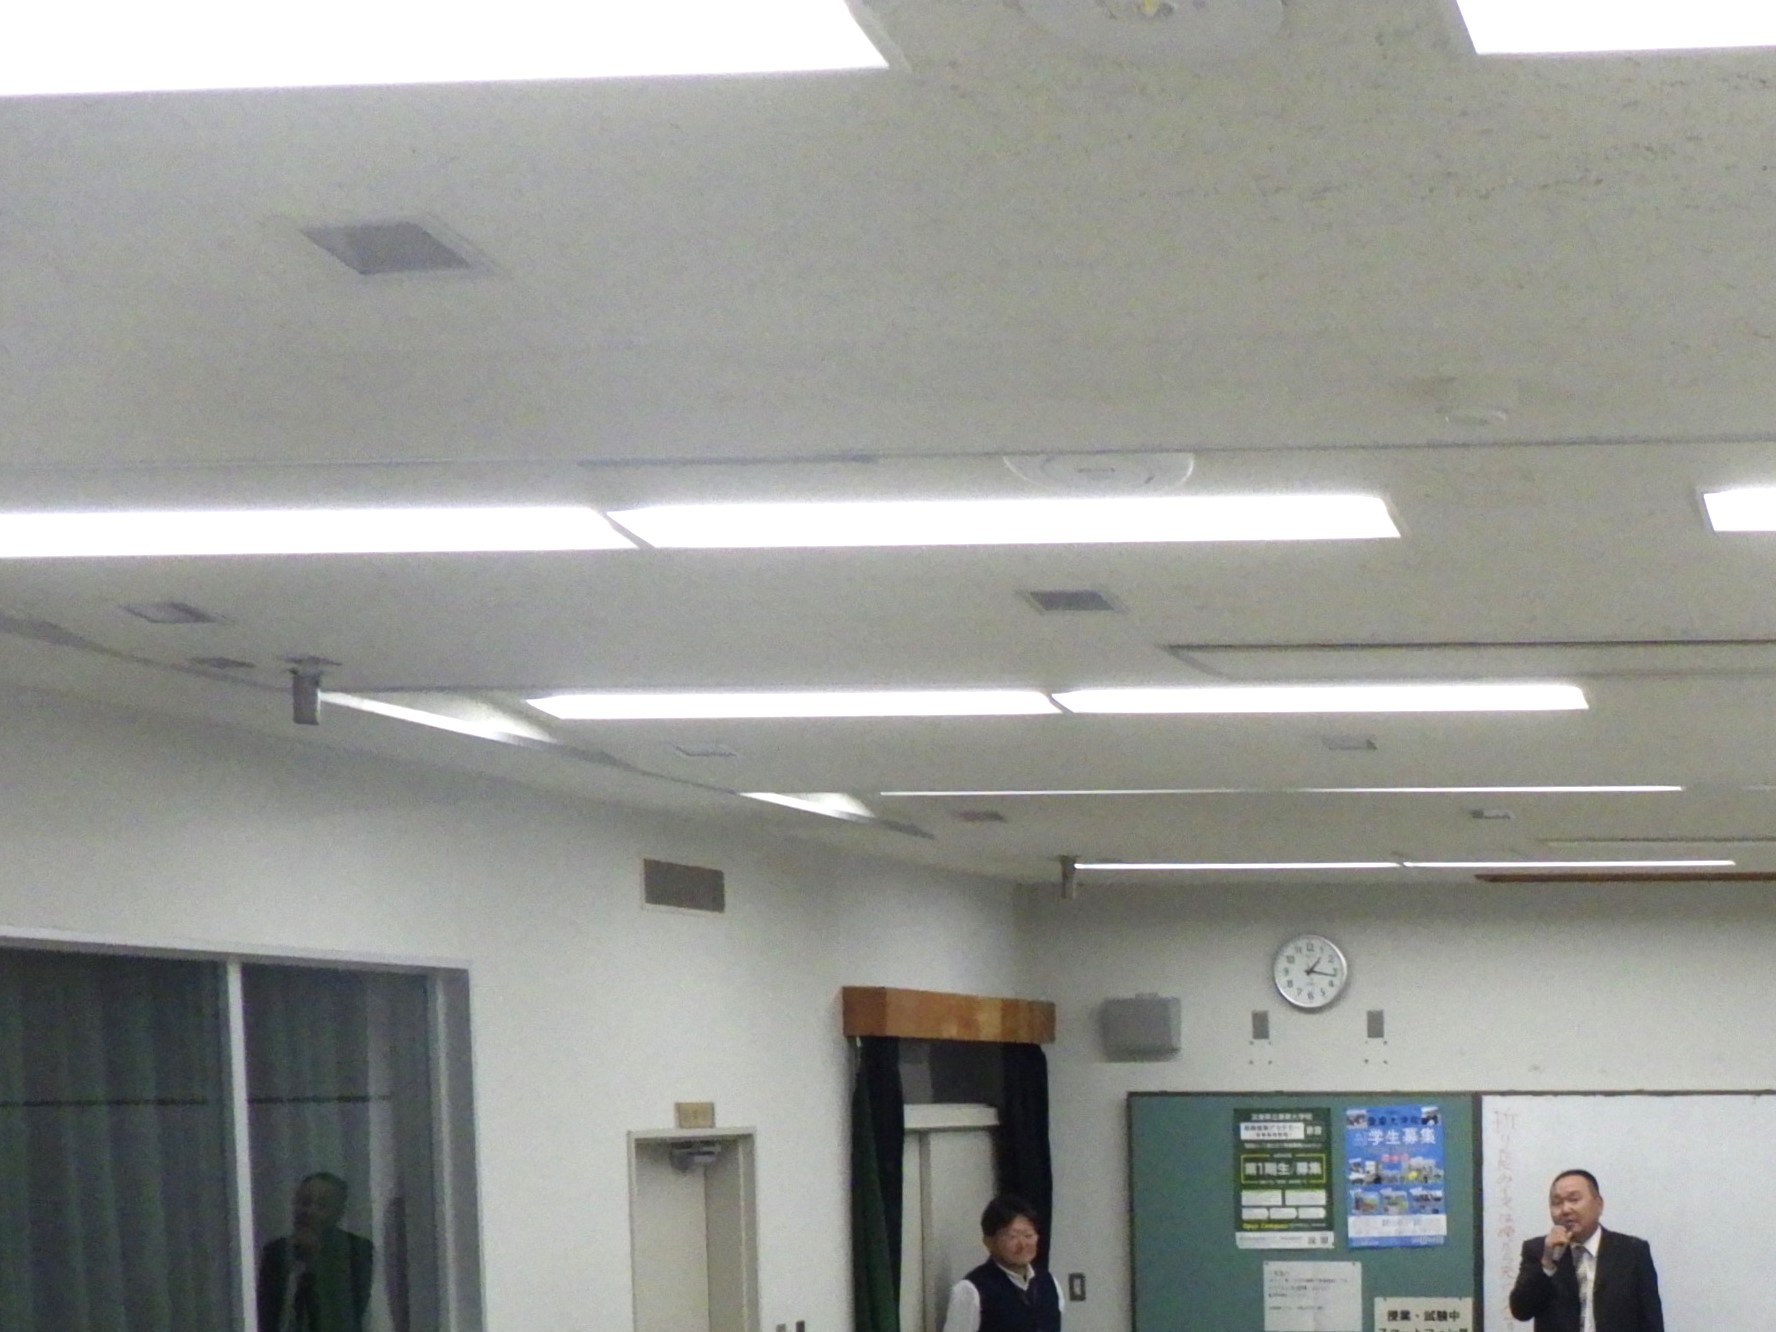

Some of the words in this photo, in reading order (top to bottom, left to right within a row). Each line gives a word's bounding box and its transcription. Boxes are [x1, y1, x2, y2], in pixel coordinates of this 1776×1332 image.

[1367, 1127, 1436, 1146] 学生募集
[1387, 1309, 1460, 1322] 授業・試験中
